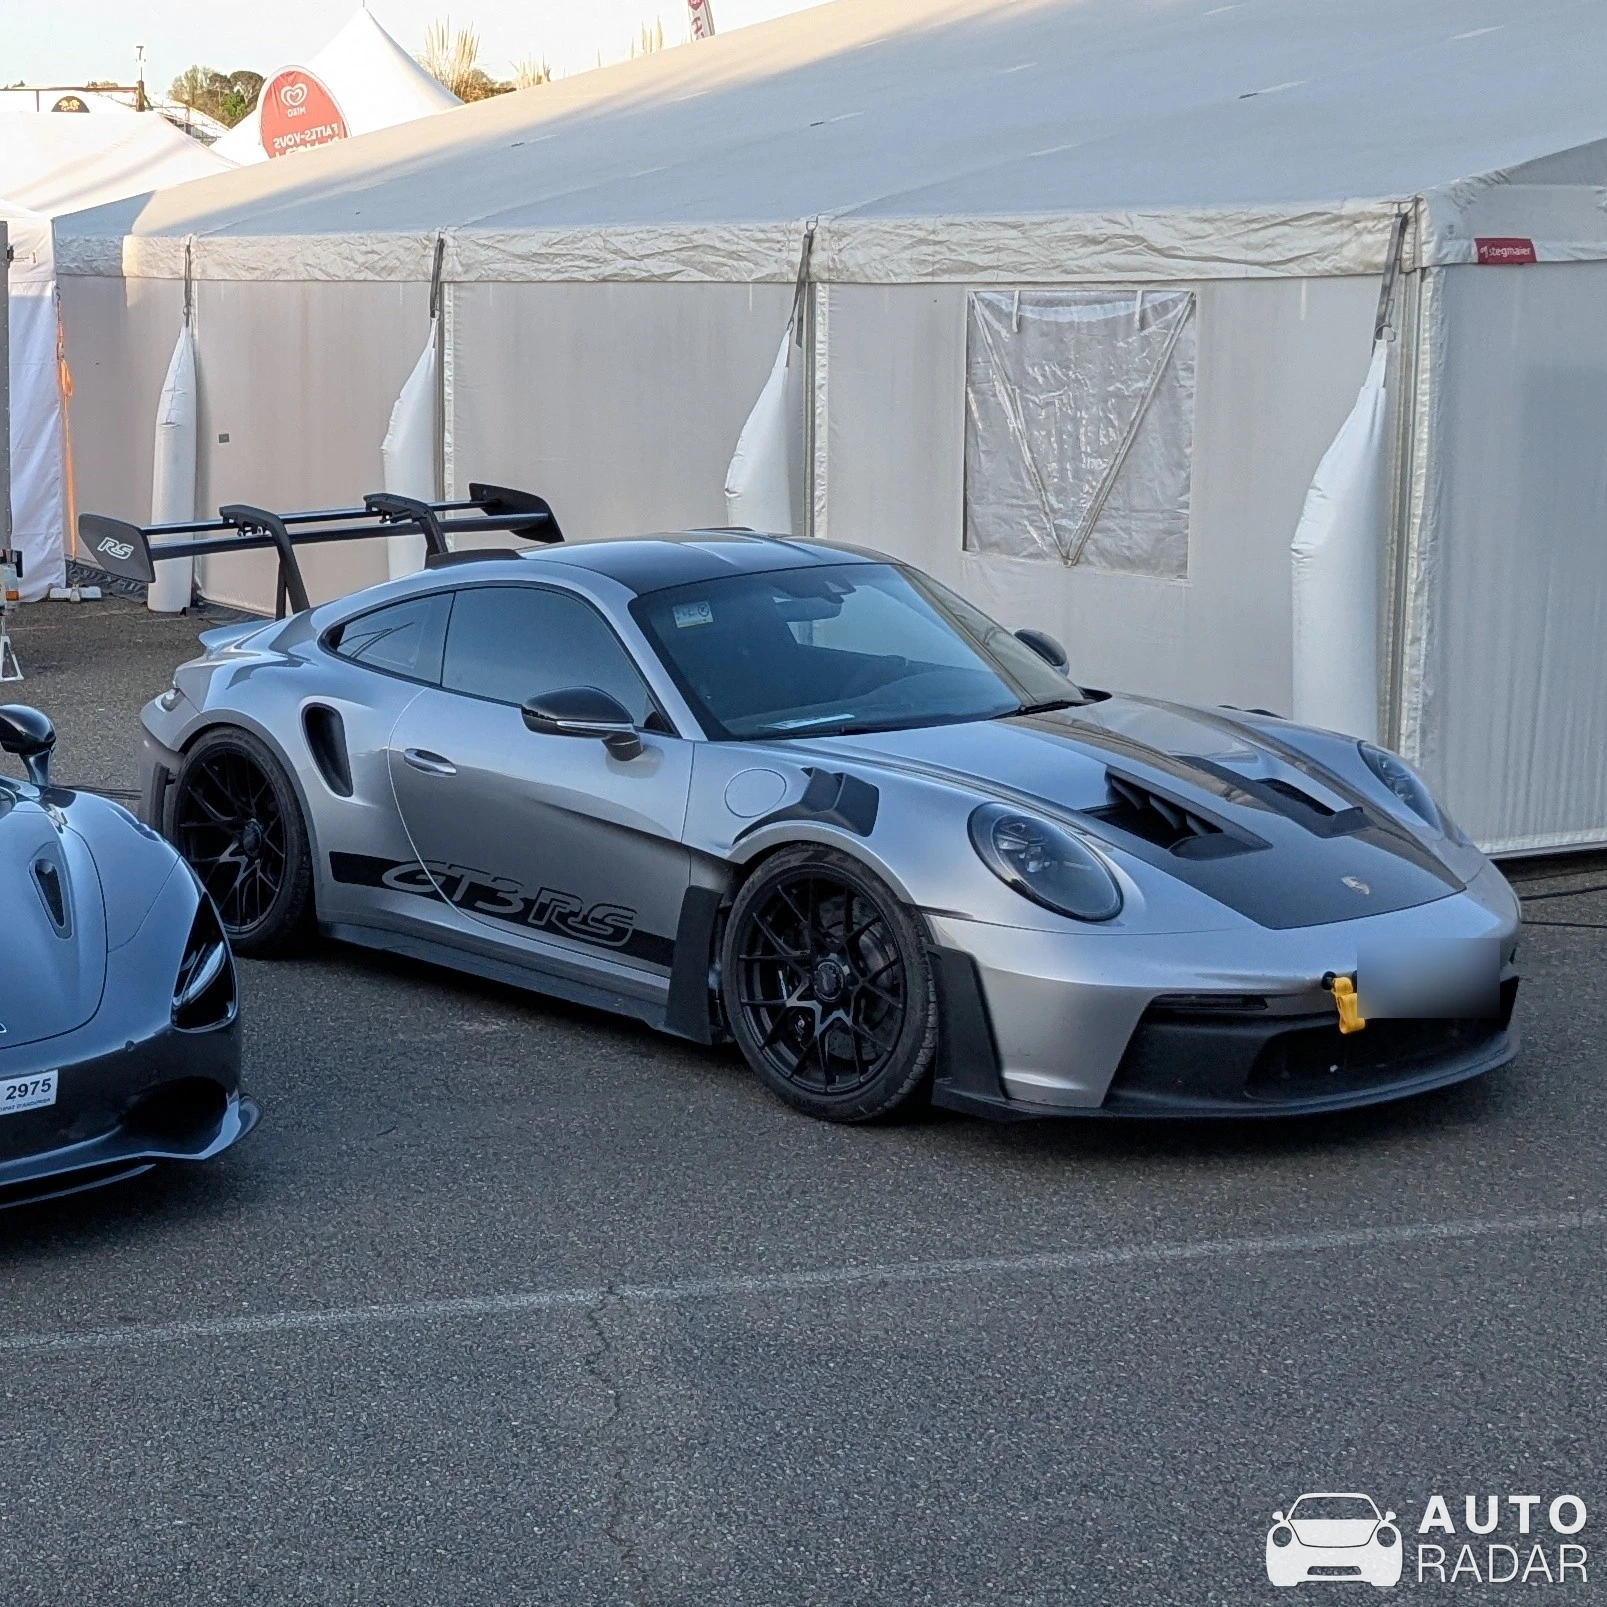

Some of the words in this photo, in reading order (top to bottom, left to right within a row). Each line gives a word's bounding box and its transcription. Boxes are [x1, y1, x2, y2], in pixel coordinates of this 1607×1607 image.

[1489, 246, 1532, 258] stegmaier
[97, 536, 134, 560] RS
[5, 1077, 52, 1101] 2975
